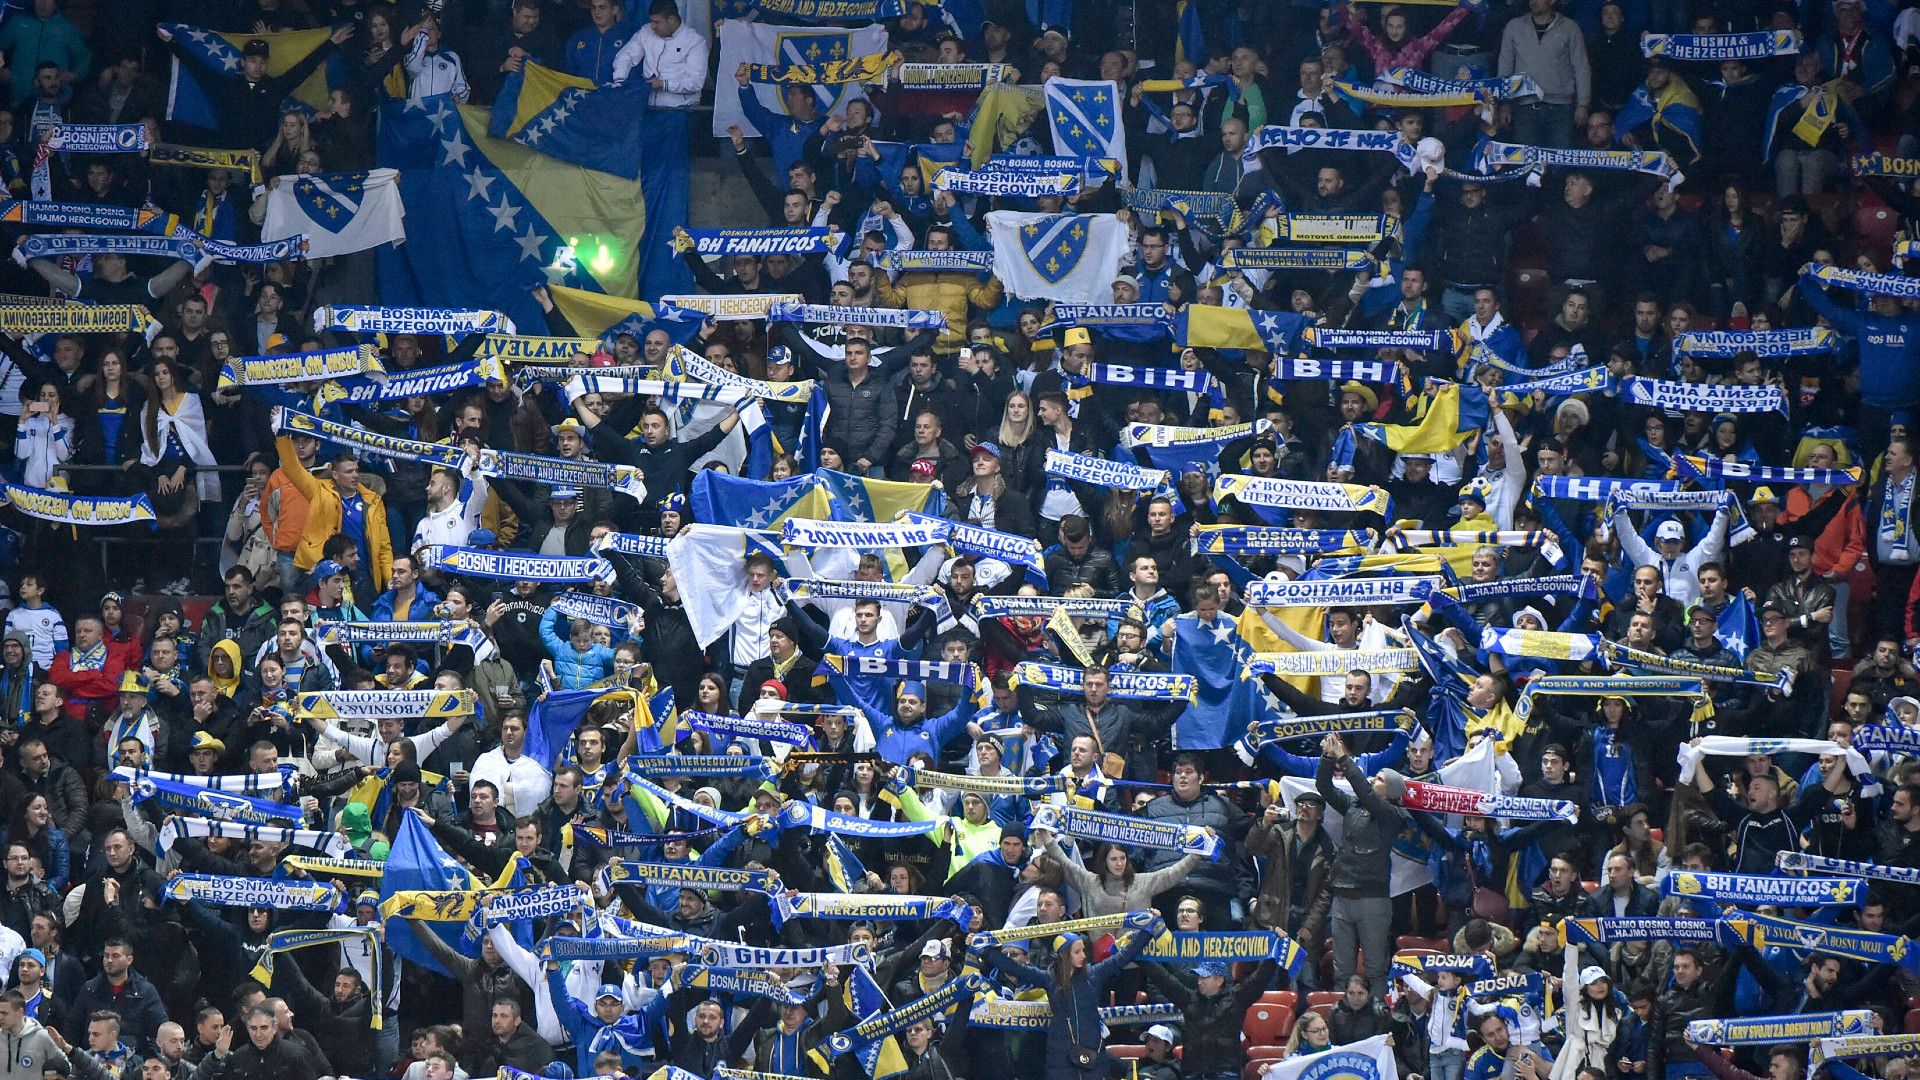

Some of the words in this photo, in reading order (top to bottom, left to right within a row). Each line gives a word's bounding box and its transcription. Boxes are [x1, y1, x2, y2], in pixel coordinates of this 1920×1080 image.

[1675, 43, 1767, 58] HERZEGOVINA
[64, 131, 117, 144] BOSNIEN
[968, 171, 1036, 184] BOSNIA&
[949, 179, 1057, 195] HERZEGOVINA
[69, 216, 130, 227] HERCEGOVINO
[719, 229, 753, 237] BOSNIAN
[697, 237, 721, 252] BH
[725, 235, 820, 253] FANATICOS
[381, 310, 454, 320] BOSNIA&
[815, 310, 898, 325] HERZEGOVINA
[361, 320, 474, 331] HERZEGOVINA
[1365, 336, 1432, 347] HERCEGOVINO
[1693, 329, 1812, 345] HERZEGOVINA
[406, 368, 438, 379] SUPPORT
[438, 364, 462, 374] ARMY
[1293, 359, 1384, 382] BiH
[350, 384, 378, 401] BH
[379, 369, 473, 399] FANATICOS
[321, 422, 344, 438] BH
[345, 427, 434, 456] FANATICOS
[1072, 455, 1141, 476] BOSNIA&
[508, 462, 536, 478] BOSNIA
[537, 465, 554, 479] AND
[553, 467, 606, 485] HERZEGOVINA
[1050, 461, 1157, 488] HERZEGOVINA
[1262, 481, 1331, 496] BOSNIA&
[1242, 491, 1352, 510] HERZEGOVINA
[950, 529, 1036, 556] ANATICOS
[1246, 531, 1305, 542] BOSNA
[1306, 531, 1320, 541] &
[964, 543, 1000, 557] SUPPORT
[1001, 549, 1025, 561] ARMY
[1246, 541, 1320, 549] HERZEGOVINA
[459, 552, 497, 573] BOSNE
[504, 557, 583, 578] HERCEGOVINE
[1511, 582, 1579, 595] HERCEGOVINO
[350, 629, 438, 641] HERZEGOVINA
[1279, 654, 1316, 673] BOSNIA
[1319, 653, 1341, 674] AND
[1052, 669, 1074, 683] BH
[1539, 680, 1579, 689] BOSNIA
[1582, 681, 1605, 689] AND
[1606, 681, 1681, 689] HERZEGOVINA
[325, 692, 431, 703] HERZEGOVINA
[348, 703, 414, 715] BOSNIA&
[1273, 717, 1362, 738] FANATICOS
[1363, 716, 1385, 730] BH
[680, 757, 752, 768] HERCEGOVINA
[1495, 796, 1551, 812] BOSNIEN
[1069, 818, 1101, 836] BOSNIA
[1101, 823, 1119, 838] AND
[1118, 825, 1175, 846] HERZEGOVINA
[638, 865, 659, 879] BH
[660, 867, 751, 884] FANATICOS
[211, 879, 286, 893] BOSNIA&
[1706, 876, 1731, 892] BH
[1735, 878, 1832, 896] FANATICOS
[191, 888, 307, 906] HERZEGOVINA
[1715, 890, 1754, 900] BOSNIAN
[1754, 892, 1797, 902] SUPPORT
[1796, 894, 1820, 903] ARMY
[506, 899, 571, 920] BOSNIA&
[824, 905, 918, 917] HERZEGOVINA
[1604, 919, 1637, 929] HAJMO
[1638, 920, 1673, 930] BOSNO,
[1608, 929, 1648, 938] ...HAJMO
[1650, 929, 1714, 939] HERCEGOVINO
[1180, 937, 1201, 957] AND
[1203, 936, 1270, 958] HERZEGOVINA
[1425, 954, 1476, 969] BOSNA
[710, 974, 741, 991] BOSNA
[1473, 974, 1528, 994] BOSNA
[856, 1015, 890, 1036] BOSNA
[896, 983, 958, 1019] HERCEGOVINA
